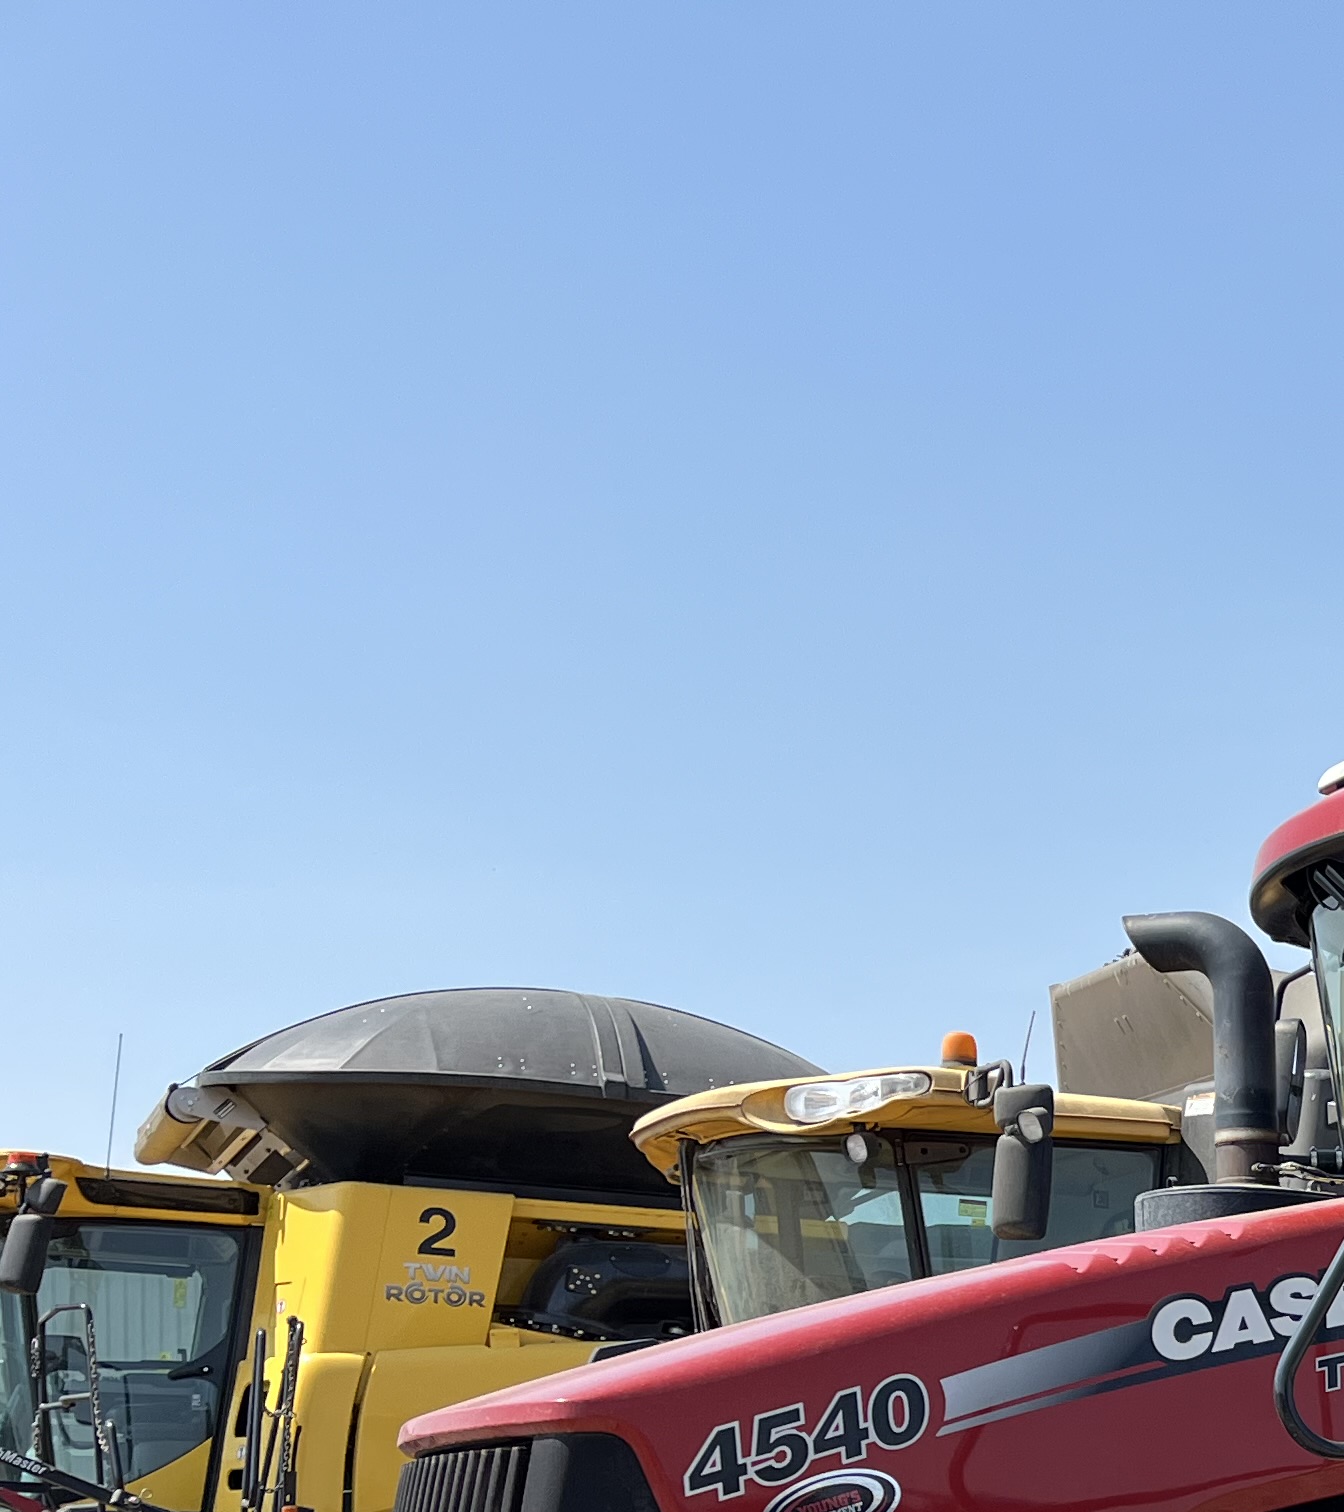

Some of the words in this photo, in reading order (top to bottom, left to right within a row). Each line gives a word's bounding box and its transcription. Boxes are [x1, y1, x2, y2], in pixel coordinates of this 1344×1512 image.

[417, 1207, 456, 1257] 2
[402, 1261, 471, 1285] TWIN
[384, 1281, 486, 1308] ROTOR
[683, 1373, 930, 1502] 4540
